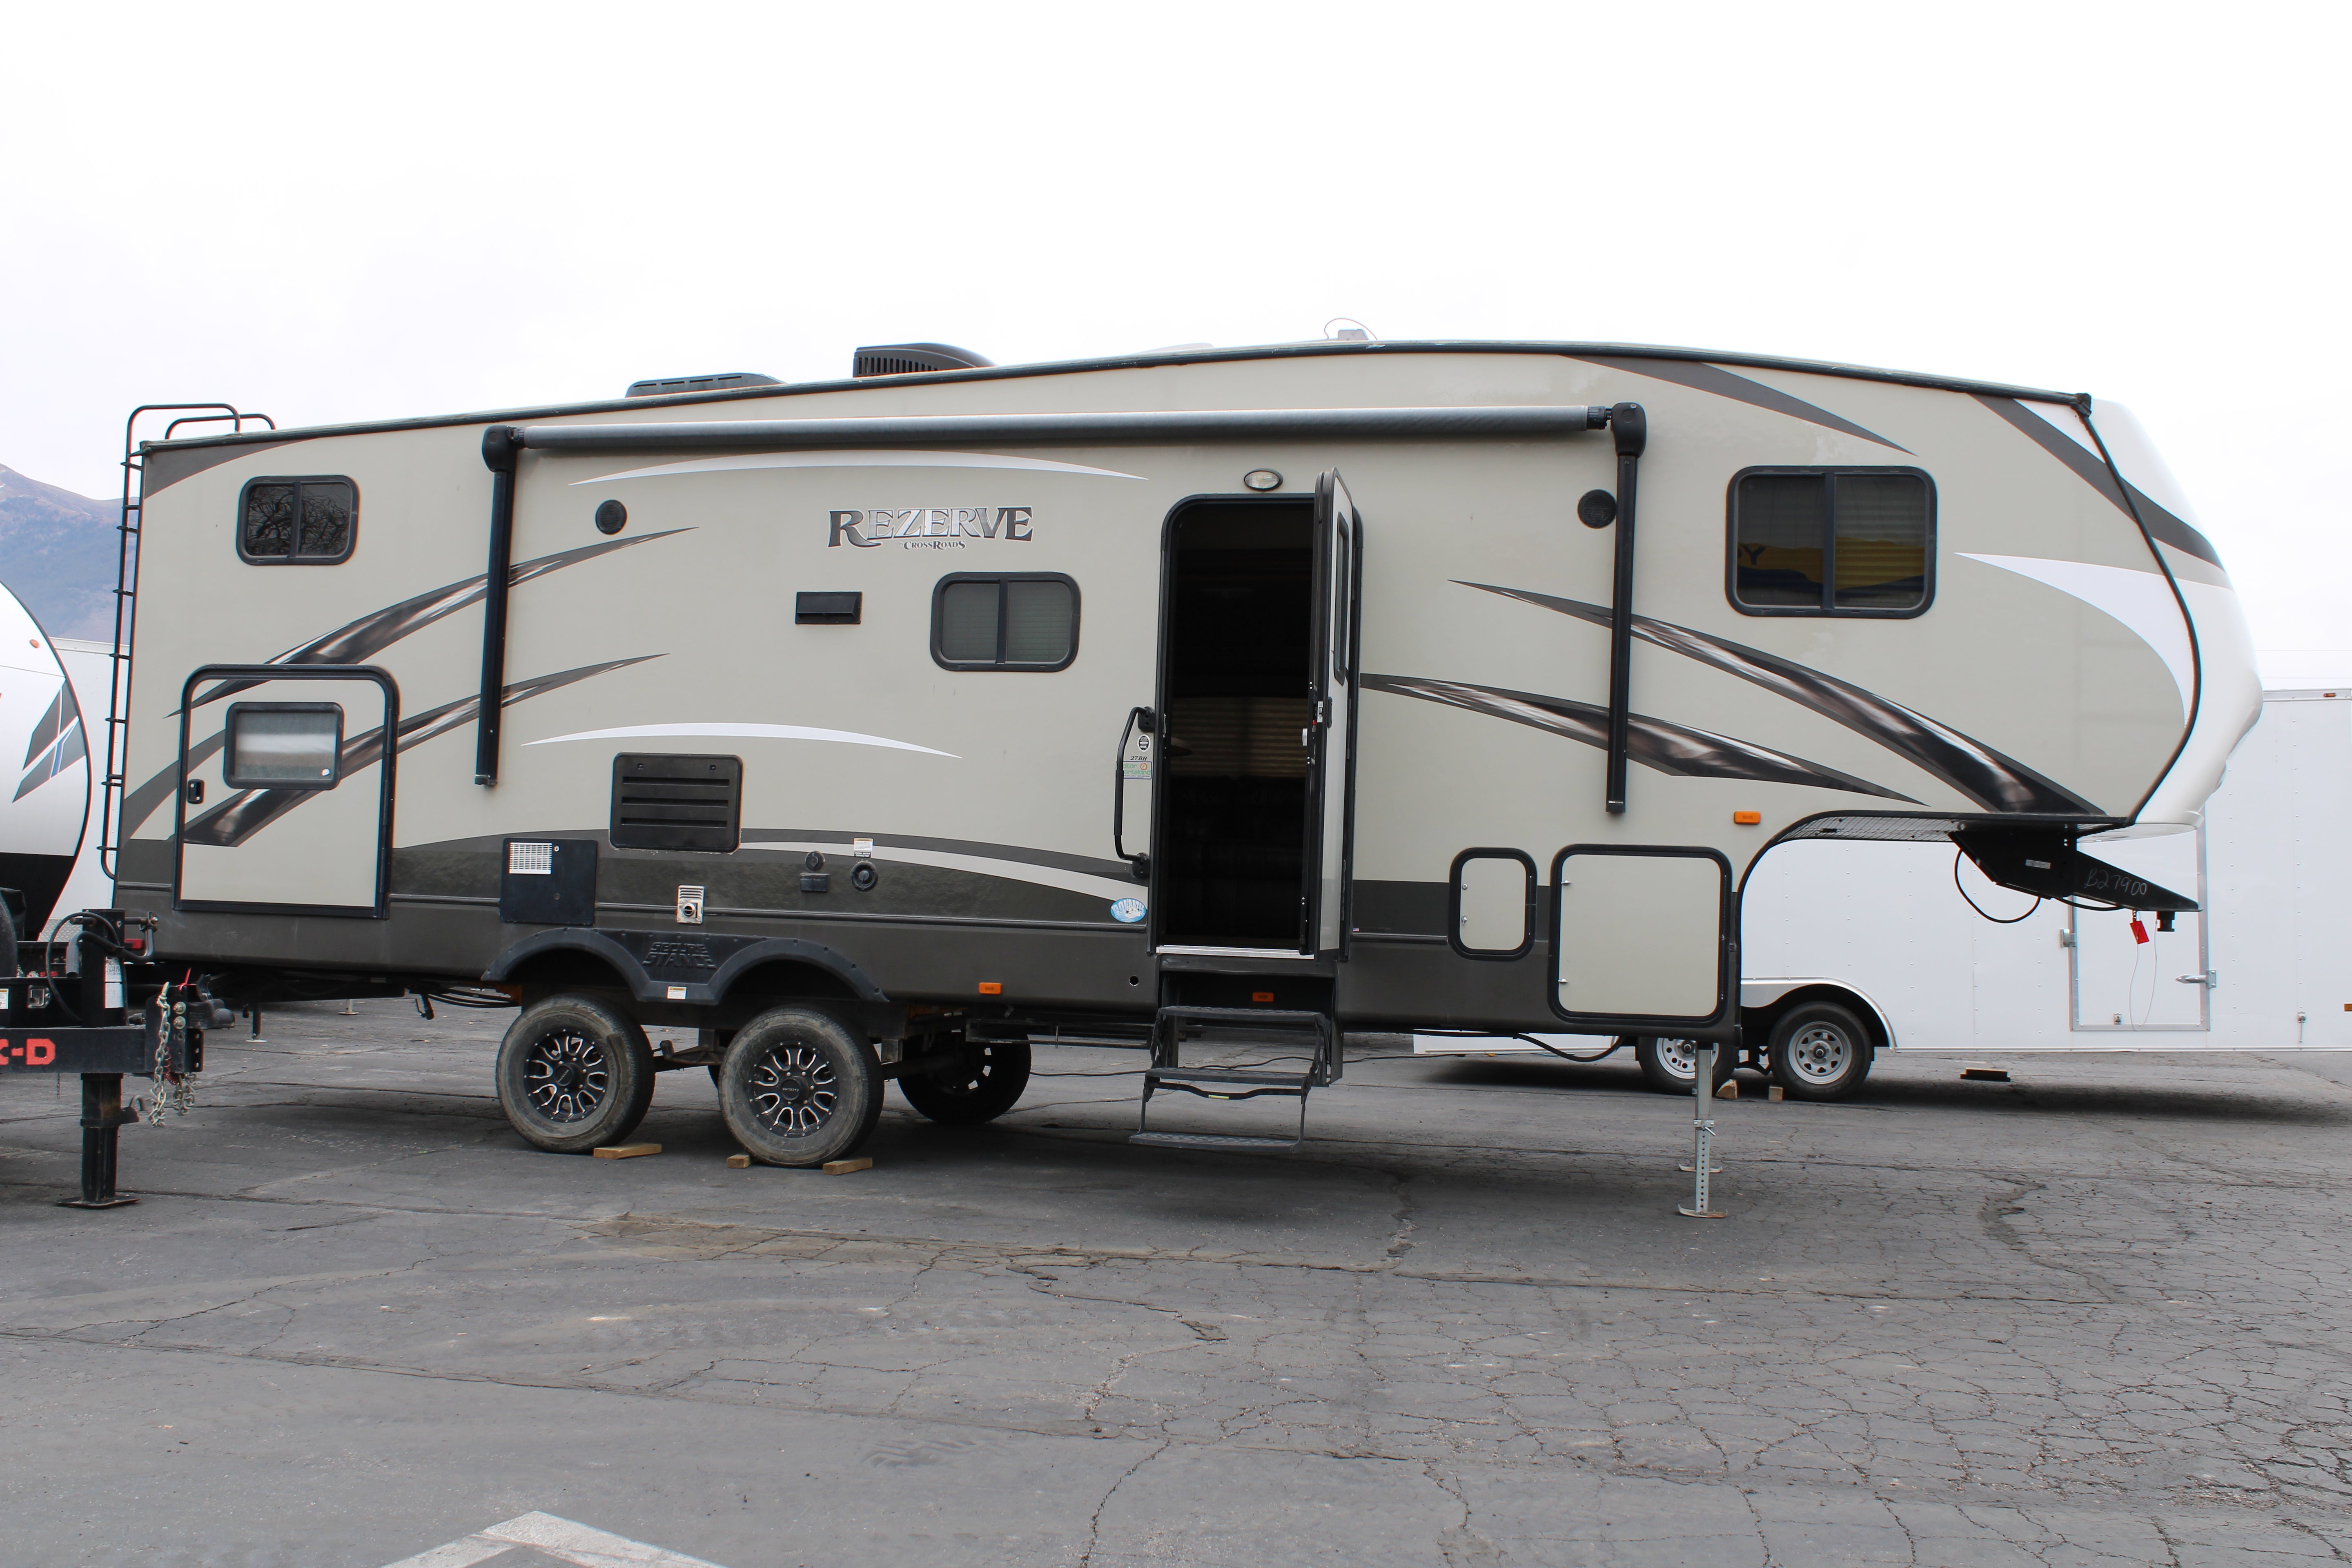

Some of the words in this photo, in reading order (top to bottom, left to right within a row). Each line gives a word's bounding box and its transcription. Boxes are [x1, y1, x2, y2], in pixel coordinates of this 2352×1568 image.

[828, 506, 1033, 548] REZERVE
[650, 942, 708, 953] SECURE
[642, 952, 717, 969] STANCE
